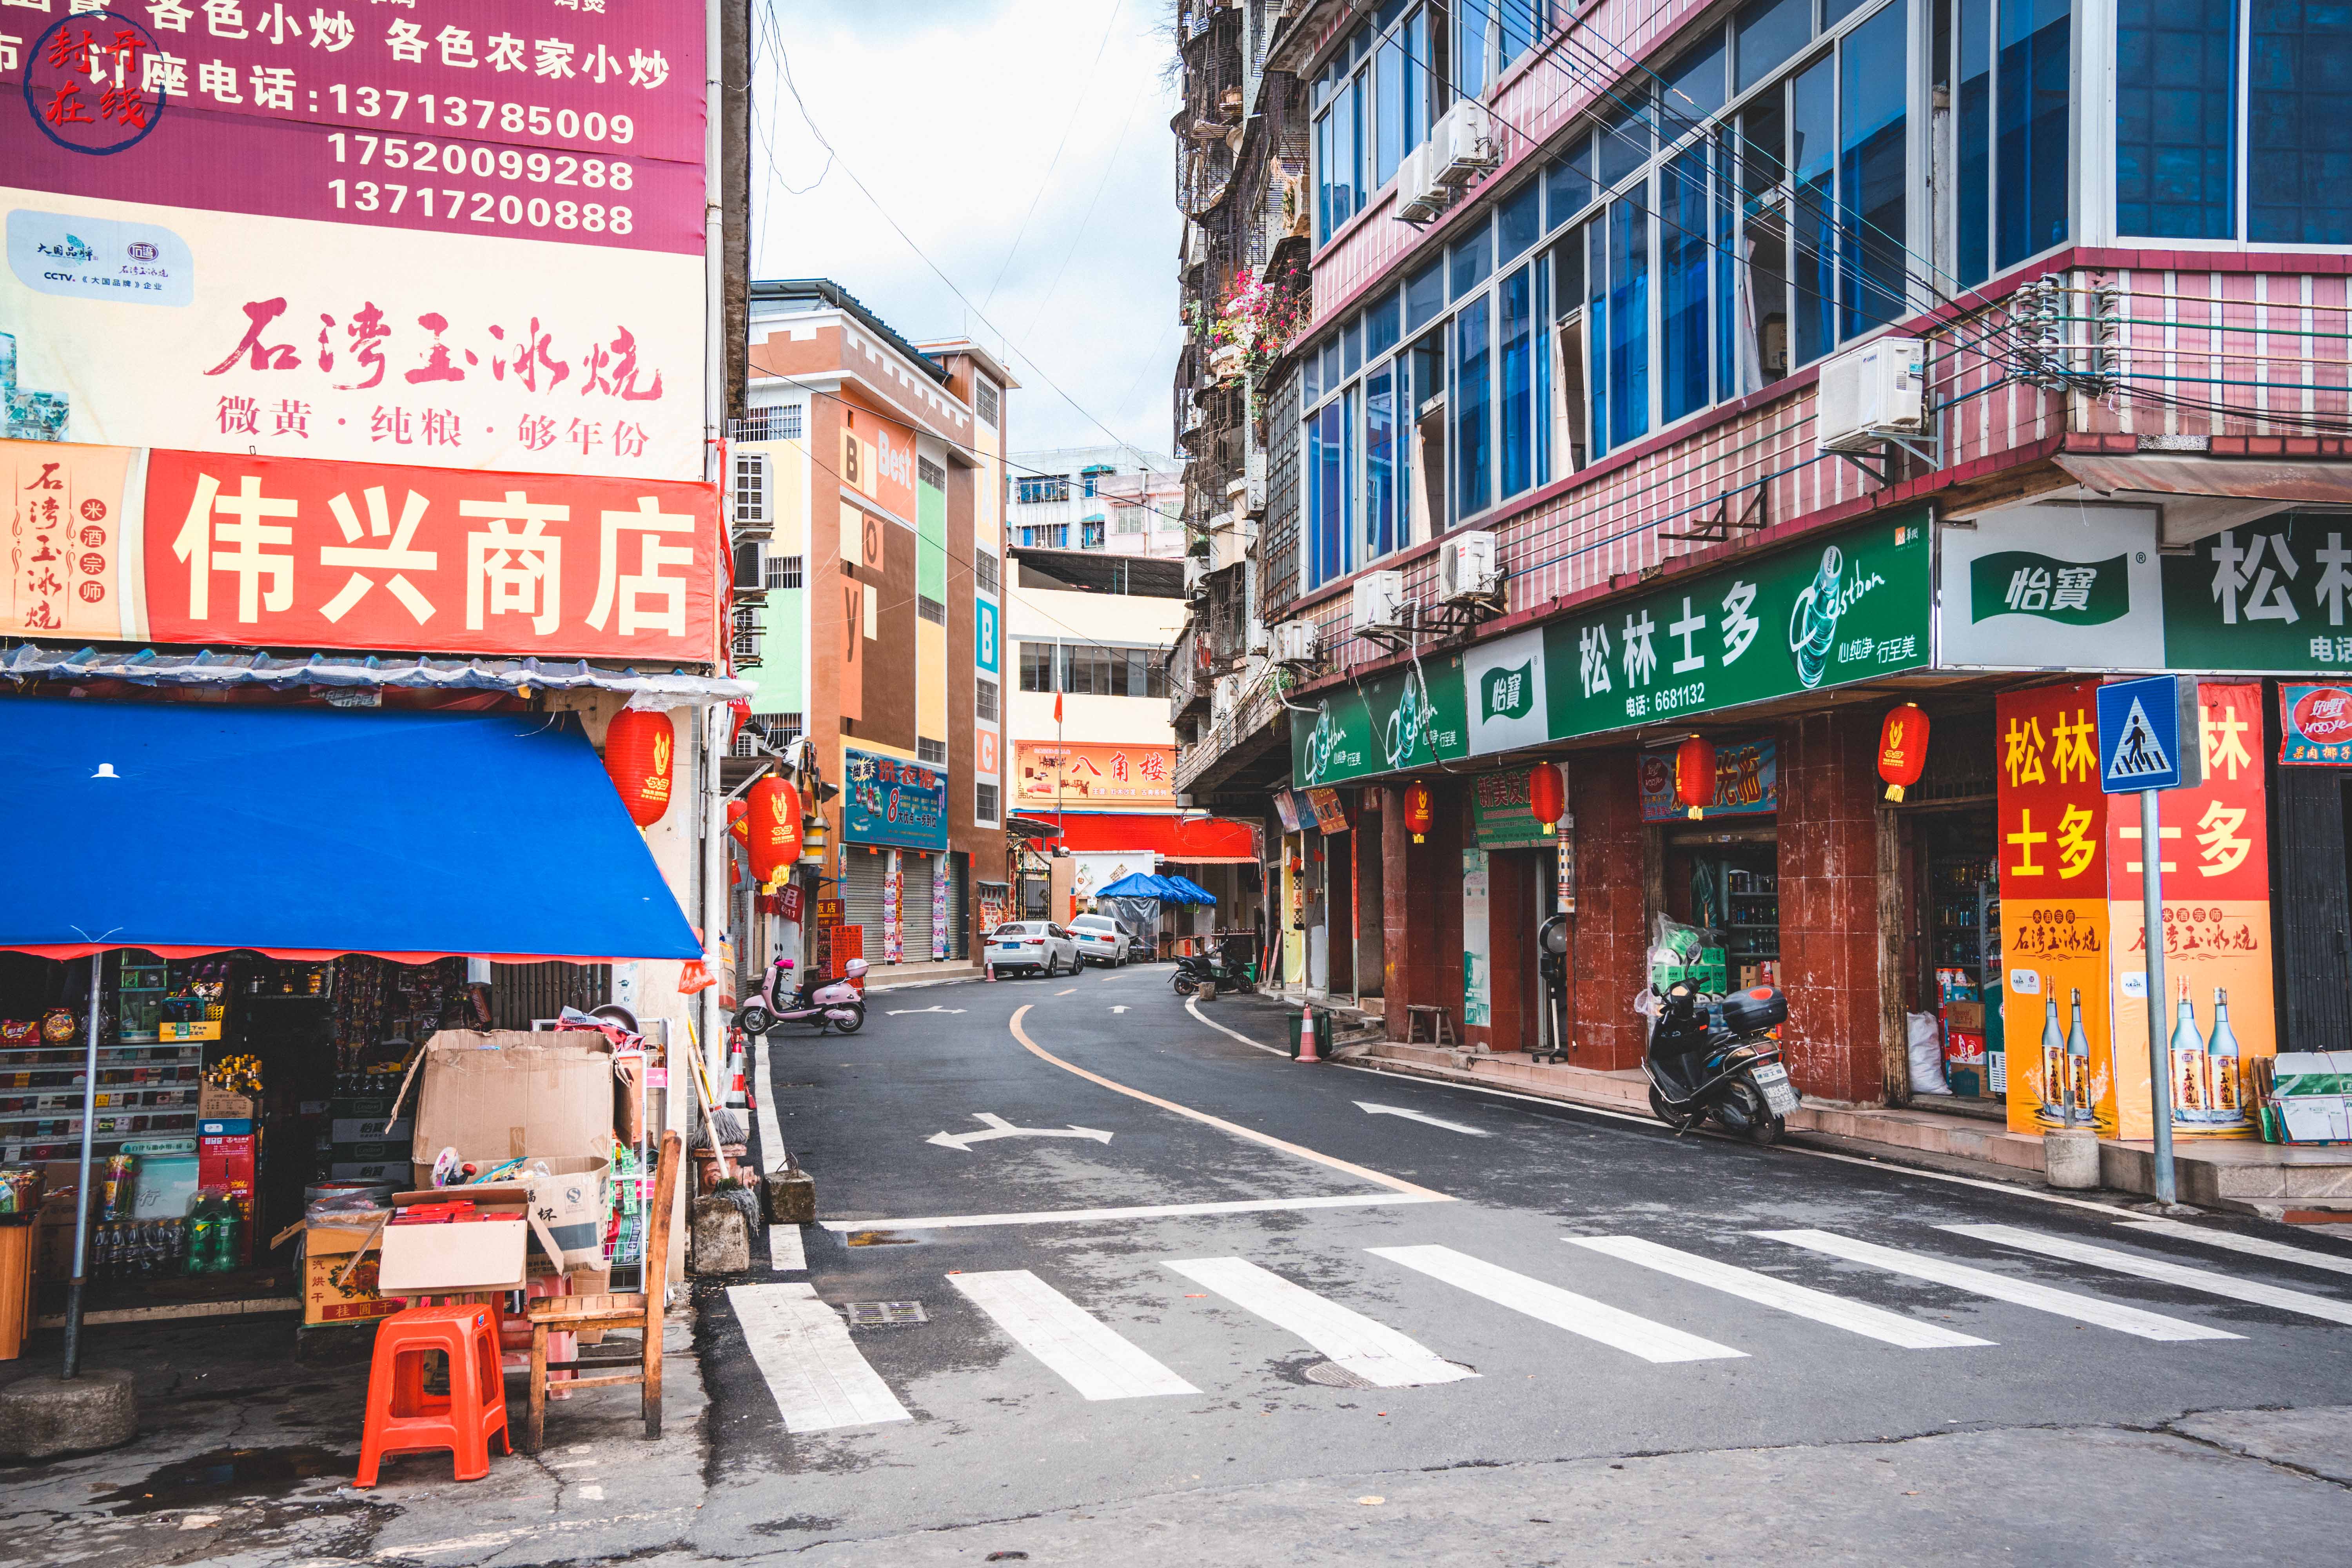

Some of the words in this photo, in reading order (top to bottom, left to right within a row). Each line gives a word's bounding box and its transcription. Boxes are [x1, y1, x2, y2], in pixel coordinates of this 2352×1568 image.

[145, 0, 355, 52] 各色小炒
[385, 18, 669, 89] 各色农家小炒
[328, 133, 633, 191] 17520099288
[328, 180, 633, 235] 13717200888
[203, 297, 662, 401] 石湾玉冰烧
[878, 429, 912, 490] Best
[24, 463, 65, 630] 石湾玉冰烧
[81, 499, 106, 602] 米酒宗师
[172, 472, 695, 637] 伟兴商店
[1580, 581, 1759, 698] 松林士多
[1838, 637, 1875, 663] 心纯净
[1877, 634, 1917, 664] 行至美
[2310, 635, 2352, 663] 电话
[878, 759, 936, 790] 洗衣液
[1071, 751, 1168, 783] 八角楼
[2005, 709, 2097, 788] 松林
[2007, 803, 2097, 879] 士多
[2012, 925, 2101, 952] 石湾玉冰烧
[2033, 909, 2076, 924] 米酒宗师
[2162, 907, 2223, 922] 米酒宗师
[311, 1260, 325, 1303] 汽烘干
